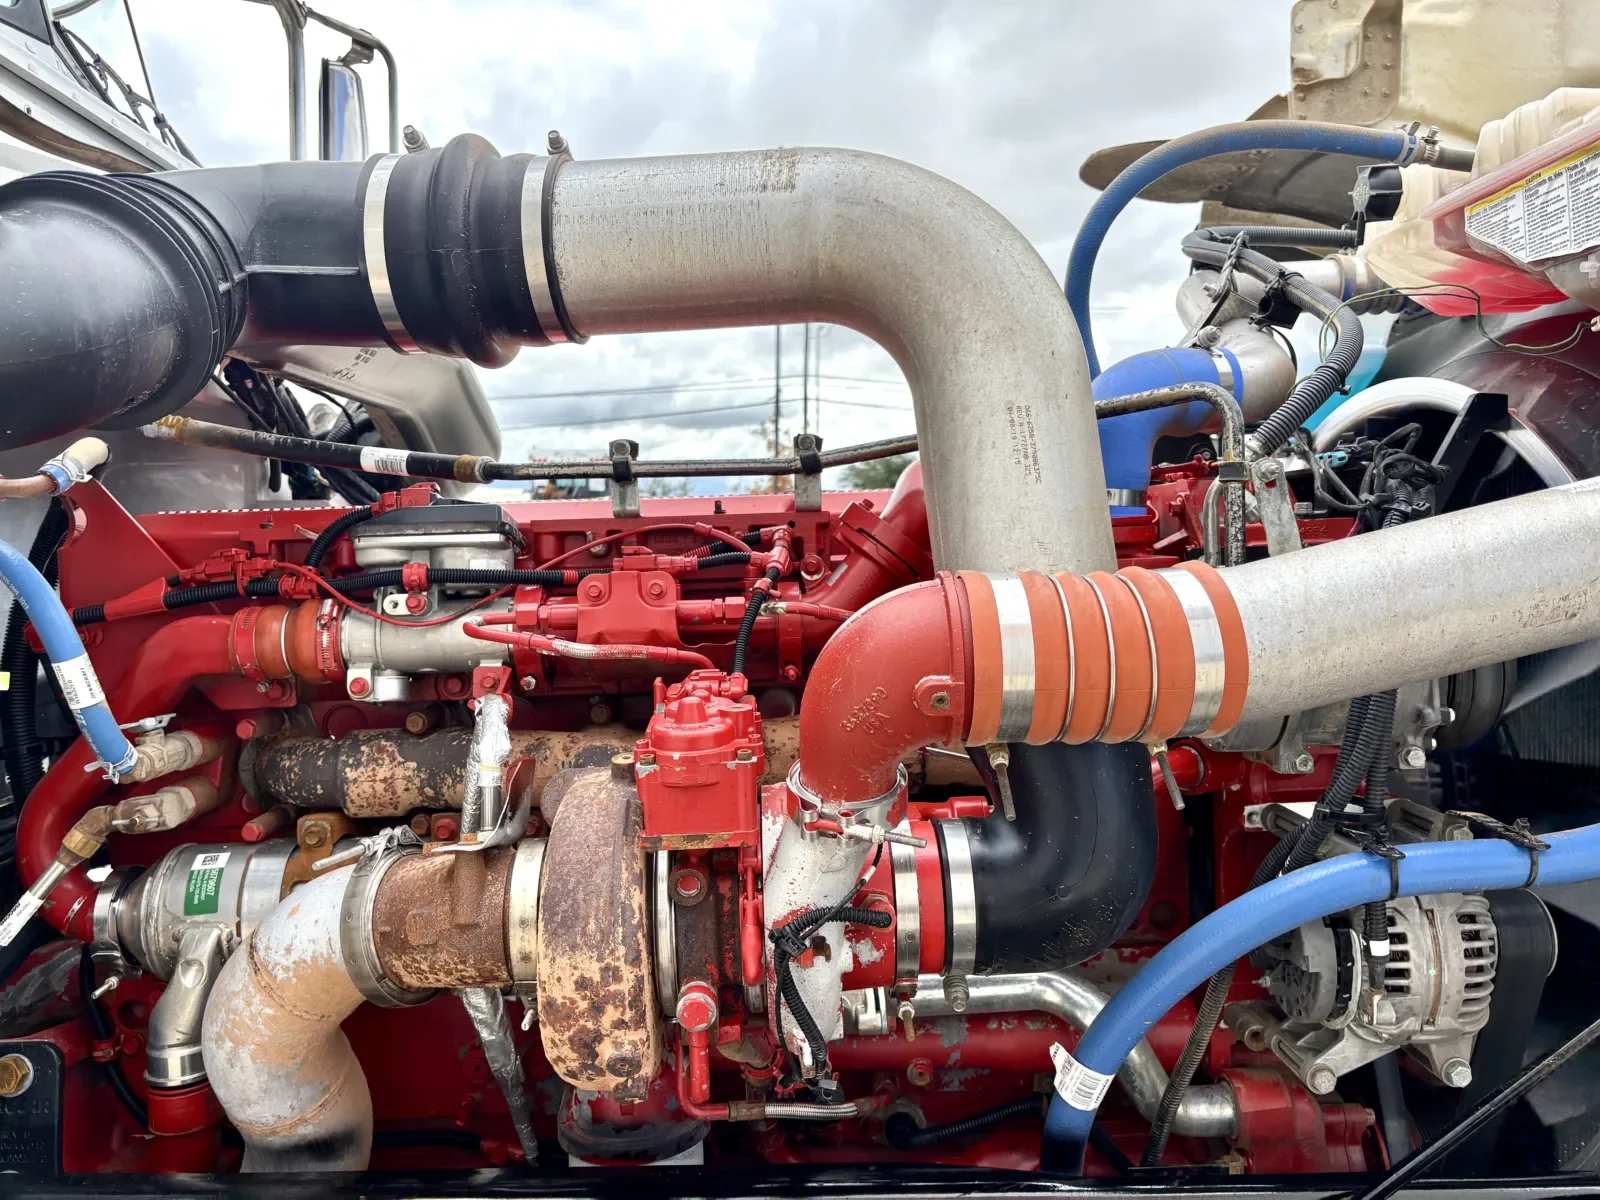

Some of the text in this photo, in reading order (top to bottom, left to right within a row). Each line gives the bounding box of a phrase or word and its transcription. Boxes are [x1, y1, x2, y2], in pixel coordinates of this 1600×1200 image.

[1016, 405, 1024, 419] REV
[80, 667, 96, 699] DYNACRAFT
[862, 712, 891, 734] USA
